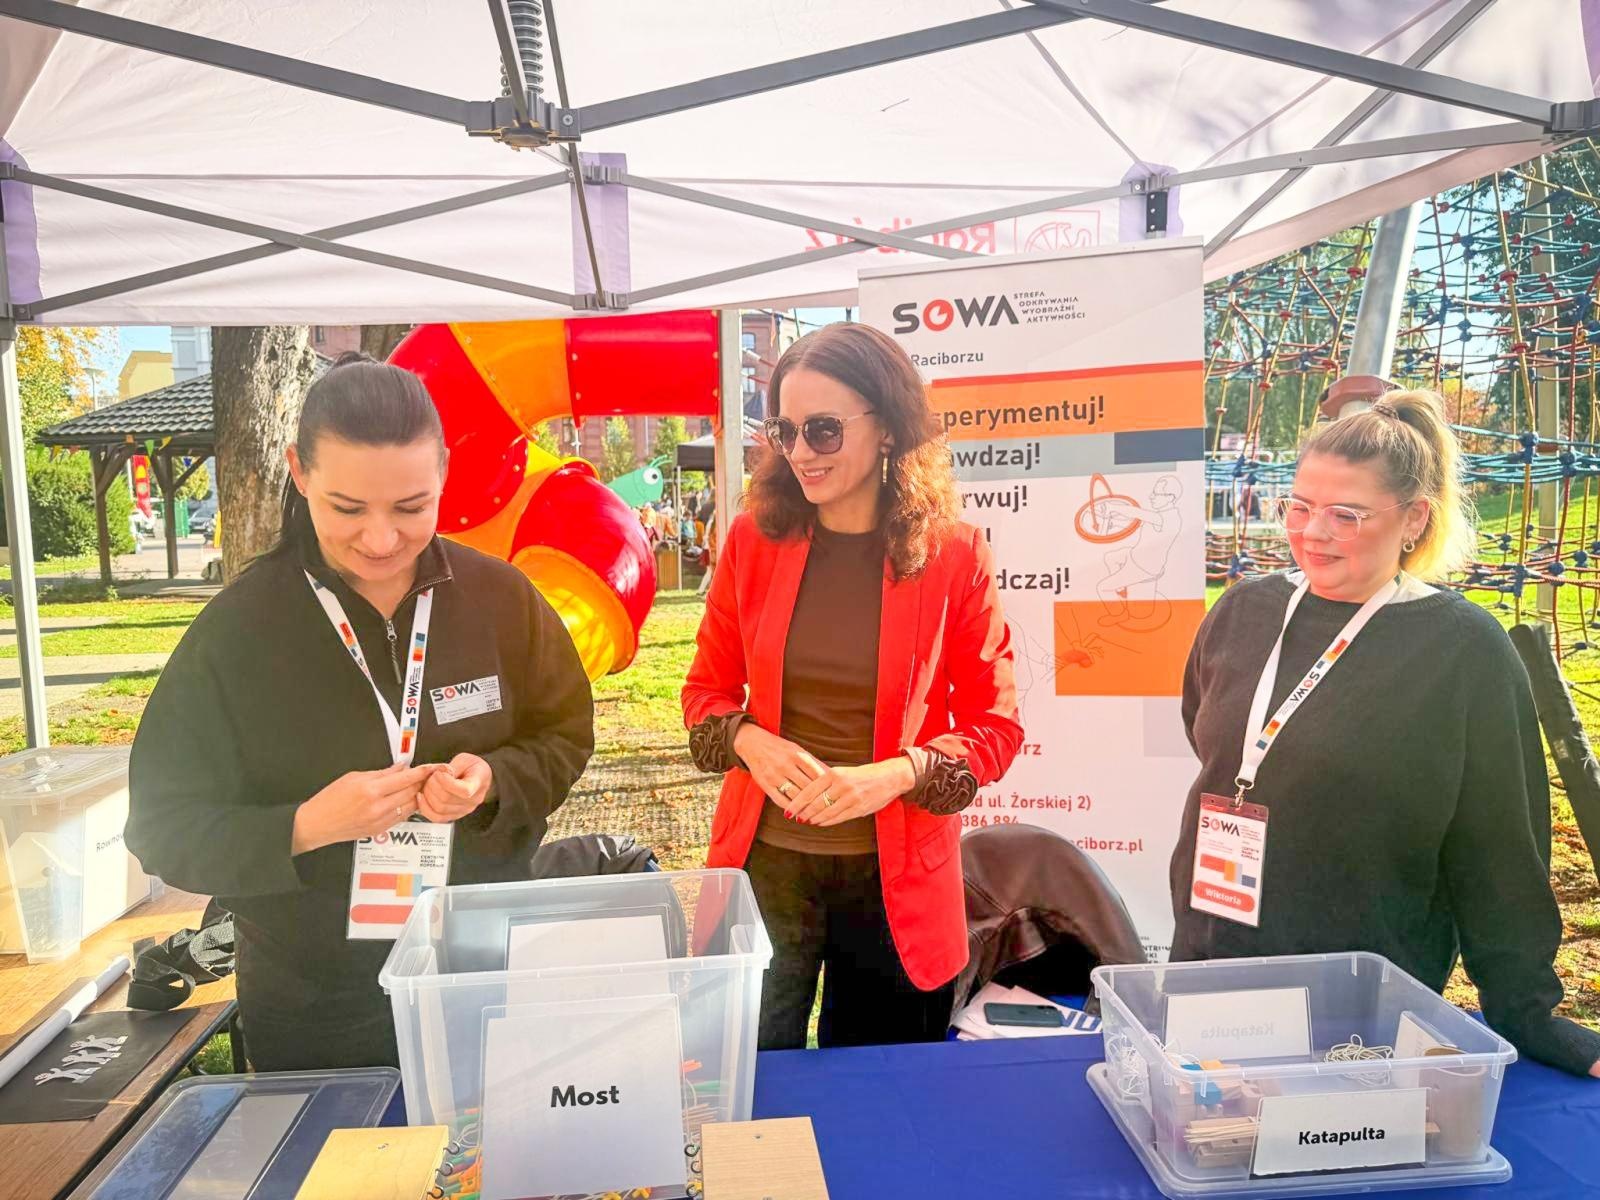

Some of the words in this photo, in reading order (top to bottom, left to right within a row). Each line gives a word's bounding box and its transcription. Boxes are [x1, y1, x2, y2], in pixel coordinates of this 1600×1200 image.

[1014, 291, 1045, 299] STREFA
[1019, 296, 1079, 307] ODKRYWANIA
[893, 294, 1019, 334] SOWA
[911, 352, 984, 366] Raciborzu
[432, 682, 480, 701] SOWA
[1290, 671, 1320, 702] SOWA
[406, 681, 420, 714] SOWA
[988, 795, 1006, 808] ul.
[1011, 792, 1072, 812] Żorskiej
[1077, 795, 1091, 811] 2)
[1201, 816, 1240, 836] SOWA
[1072, 836, 1143, 854] ciborz.pl
[551, 1085, 620, 1108] Most
[1299, 1127, 1386, 1146] Katapulta
